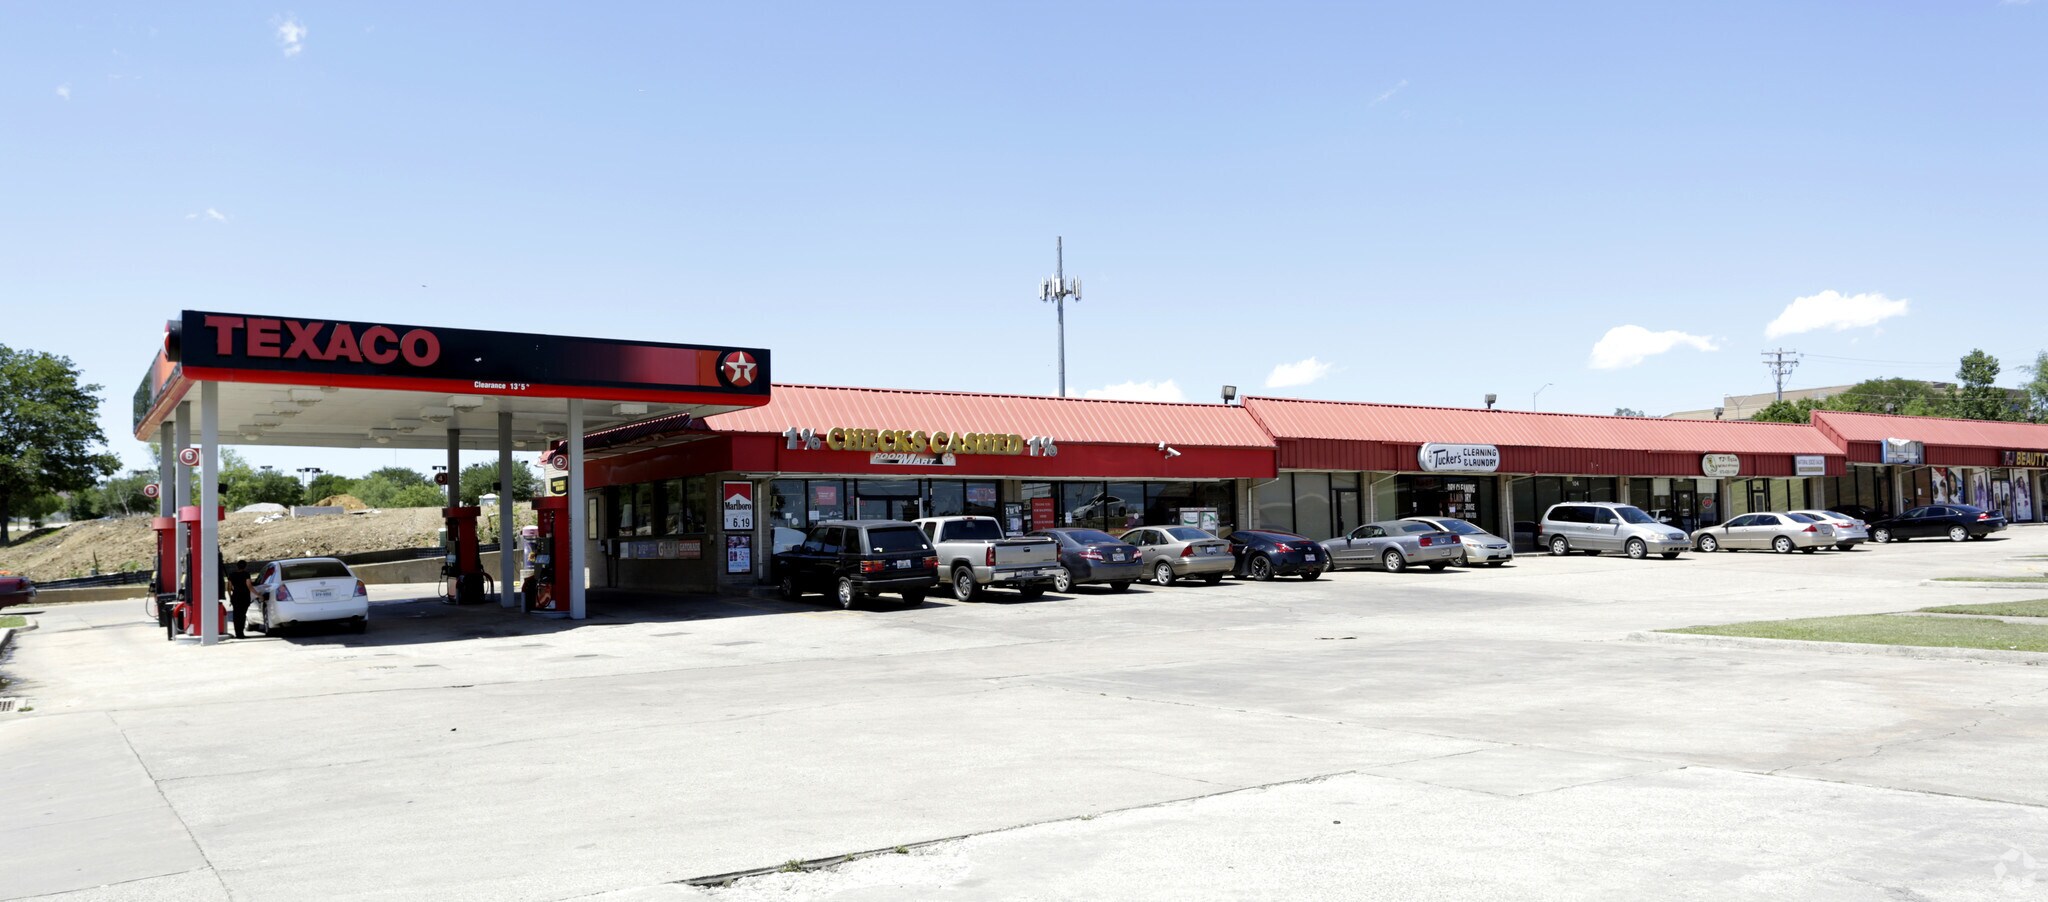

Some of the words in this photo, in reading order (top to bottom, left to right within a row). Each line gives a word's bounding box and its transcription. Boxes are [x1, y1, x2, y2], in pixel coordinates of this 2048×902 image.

[204, 315, 441, 368] TEXACO
[474, 381, 506, 389] Clearance
[783, 427, 821, 450] 1%
[826, 427, 927, 453] CHECKS
[930, 431, 1023, 455] CASHED
[1027, 435, 1057, 457] 1%
[186, 452, 192, 460] 6
[1433, 449, 1462, 468] Tucker's
[2016, 451, 2046, 467] BEAUTY
[724, 500, 751, 511] Marlboro
[733, 517, 750, 528] 6.19
[679, 542, 701, 550] GATORADE
